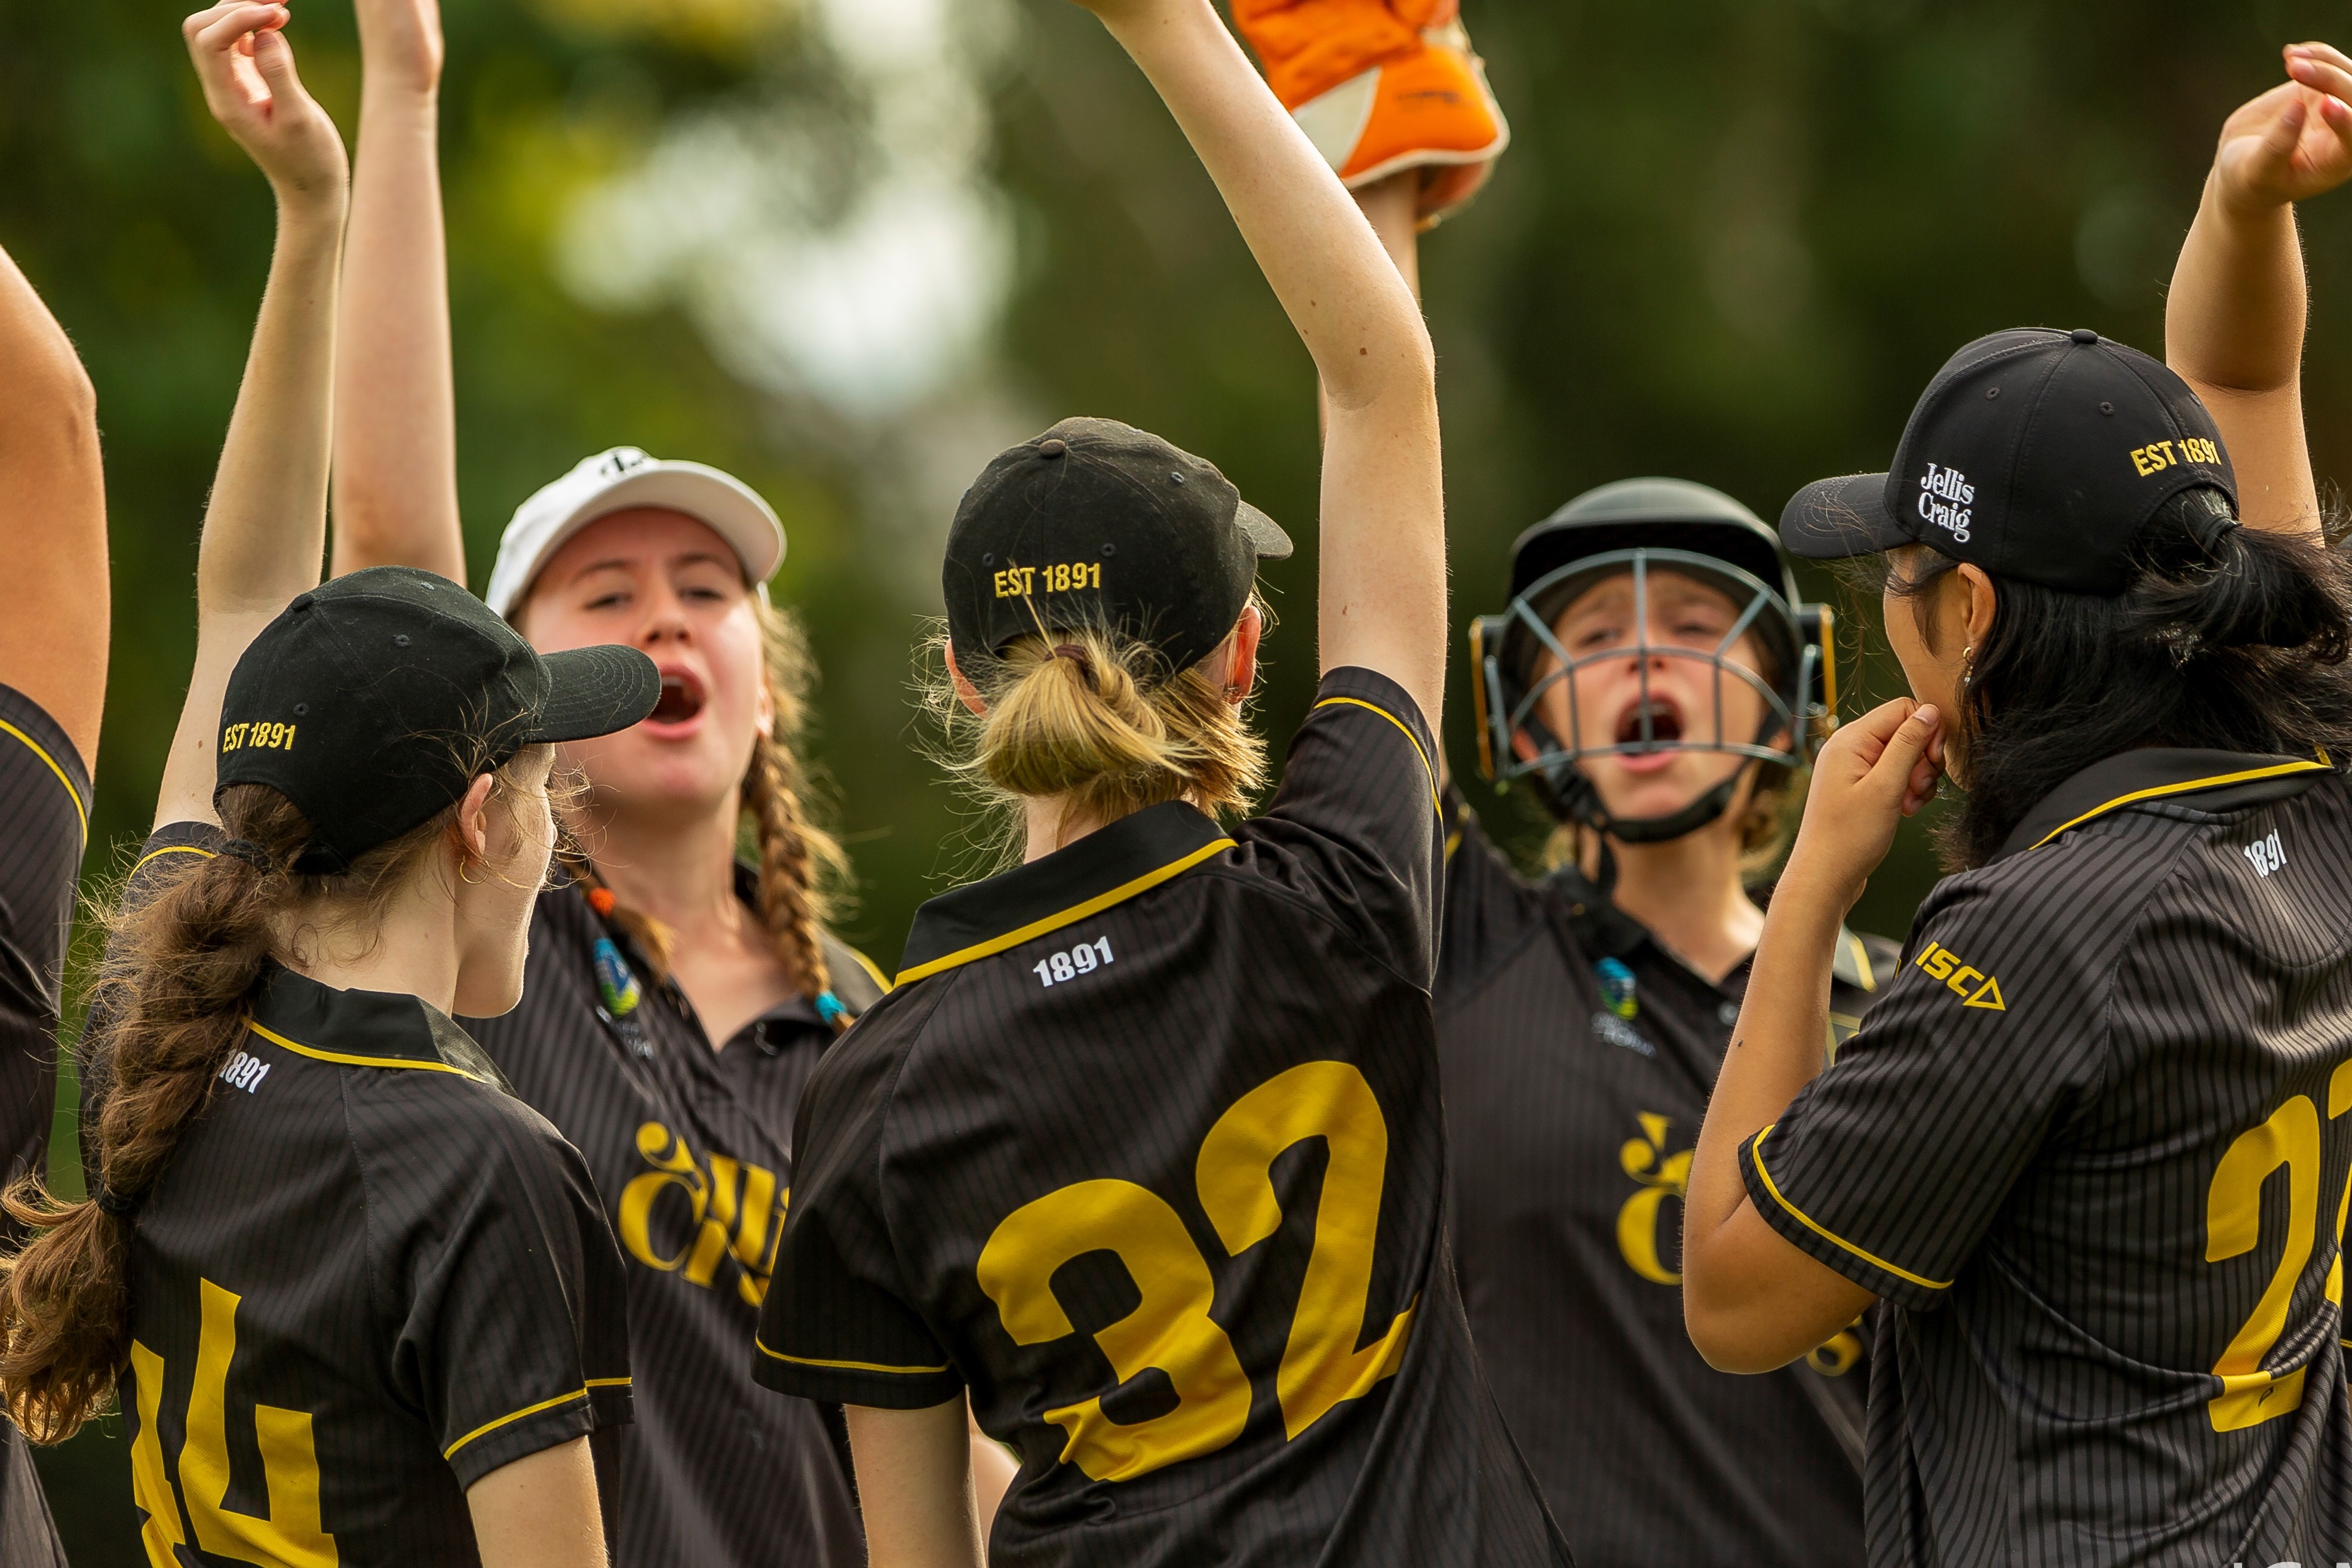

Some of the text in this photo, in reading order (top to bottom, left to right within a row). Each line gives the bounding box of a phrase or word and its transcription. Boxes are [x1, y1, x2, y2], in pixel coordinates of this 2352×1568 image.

[2130, 438, 2222, 476] EST 1891
[1921, 462, 1975, 505] Jellis
[1918, 492, 1972, 543] Craig
[994, 562, 1100, 598] EST 1891
[223, 721, 296, 754] EST 1891
[2243, 828, 2287, 878] 1891
[1033, 936, 1114, 987] 1891
[219, 1048, 271, 1094] 1891
[2206, 1057, 2352, 1432] 2
[977, 1060, 1420, 1482] 32
